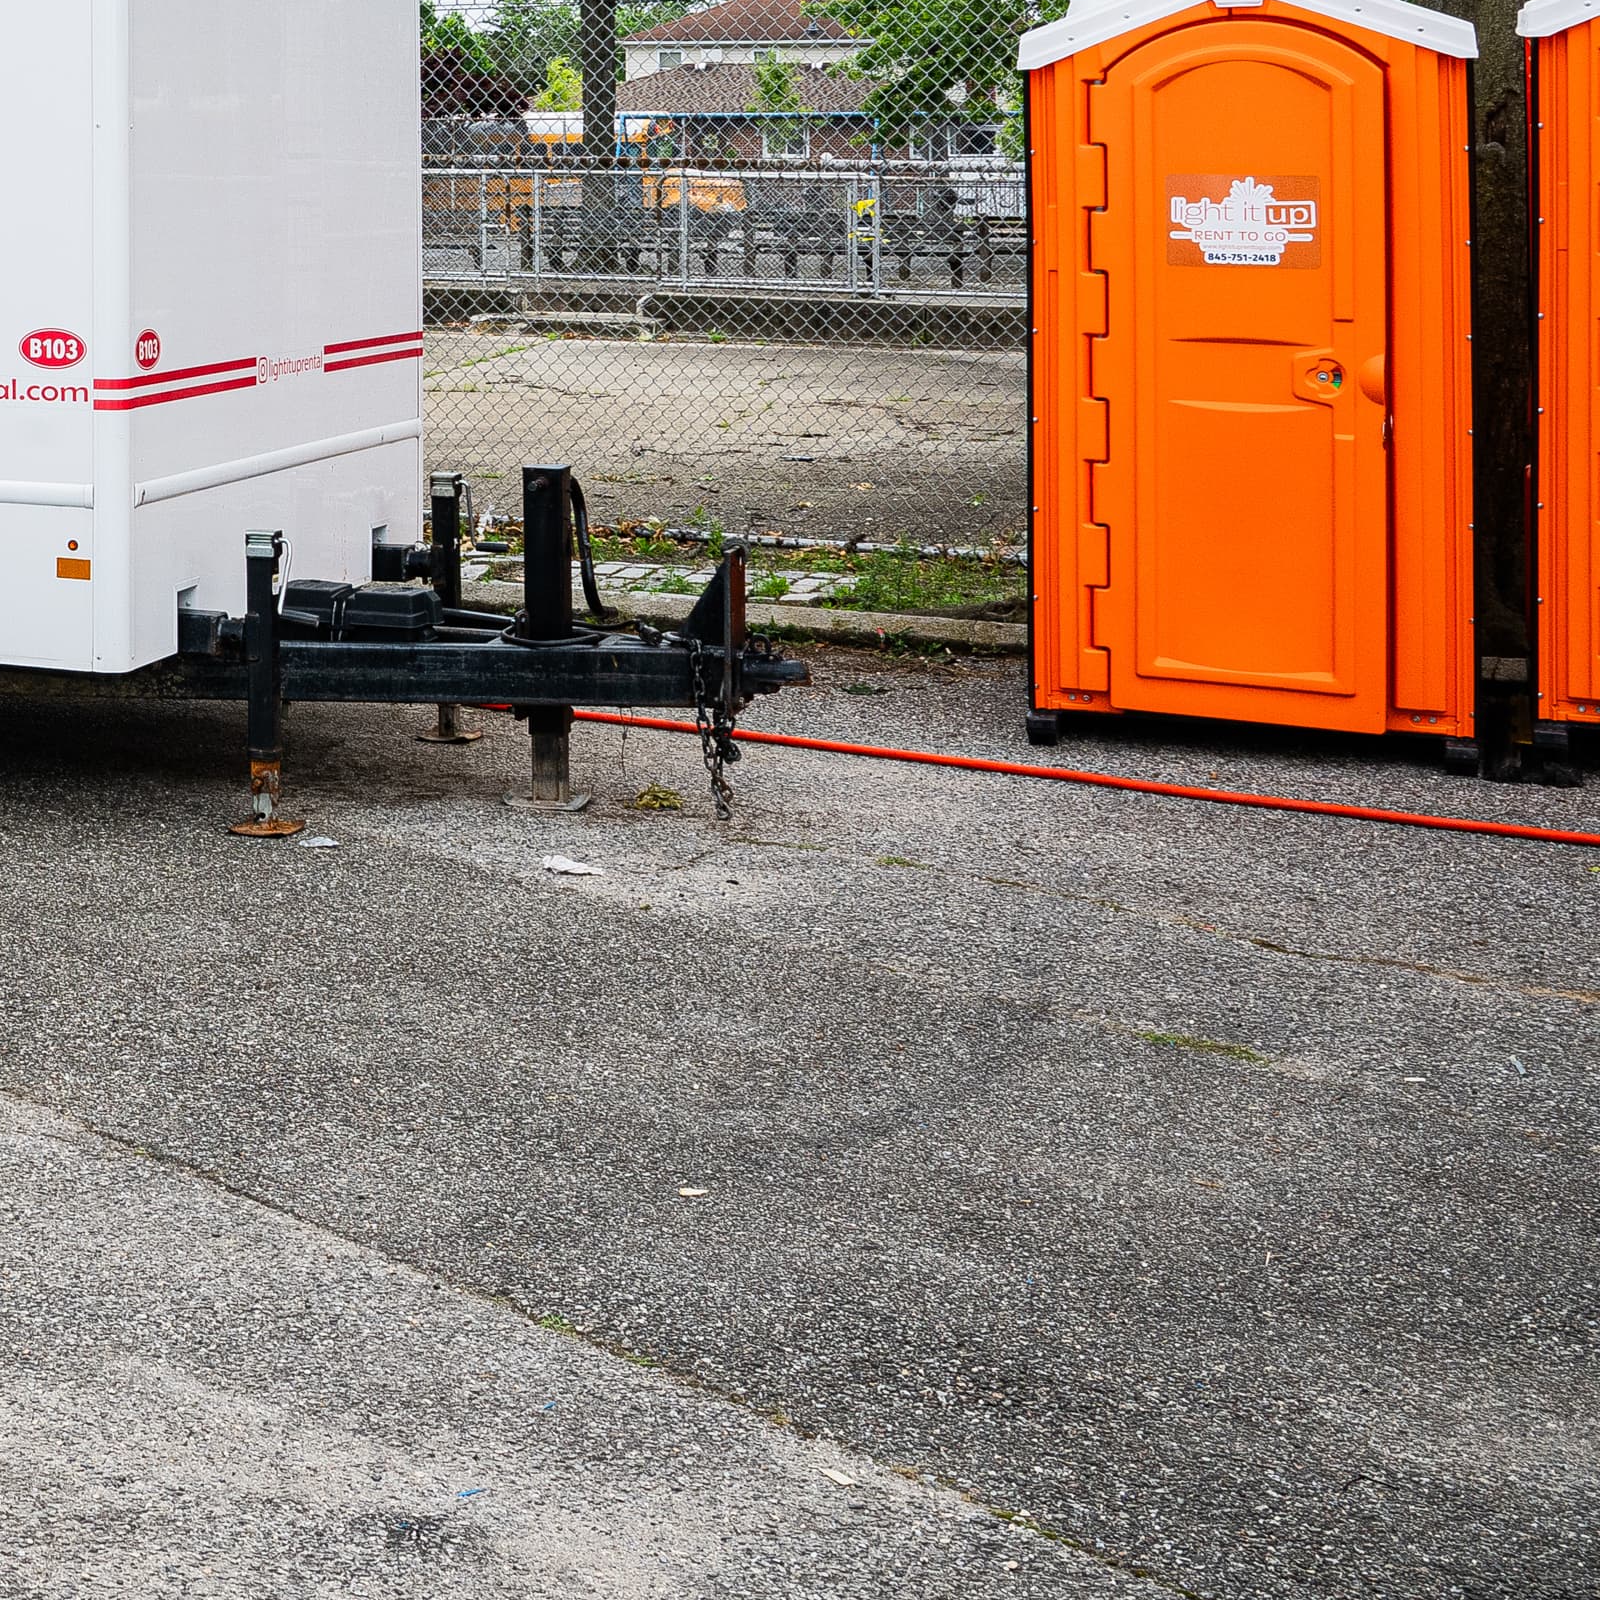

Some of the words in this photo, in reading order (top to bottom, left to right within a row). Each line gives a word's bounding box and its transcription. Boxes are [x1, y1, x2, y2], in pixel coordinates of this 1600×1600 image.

[1174, 199, 1233, 225] light
[1243, 201, 1261, 222] it
[1268, 206, 1309, 225] up
[1194, 230, 1233, 241] RENT
[1238, 230, 1259, 242] TO
[1263, 231, 1286, 242] GO
[1207, 253, 1277, 262] 845-751-2418
[29, 338, 78, 360] B103
[138, 339, 158, 361] B103
[268, 351, 323, 381] lightituprental
